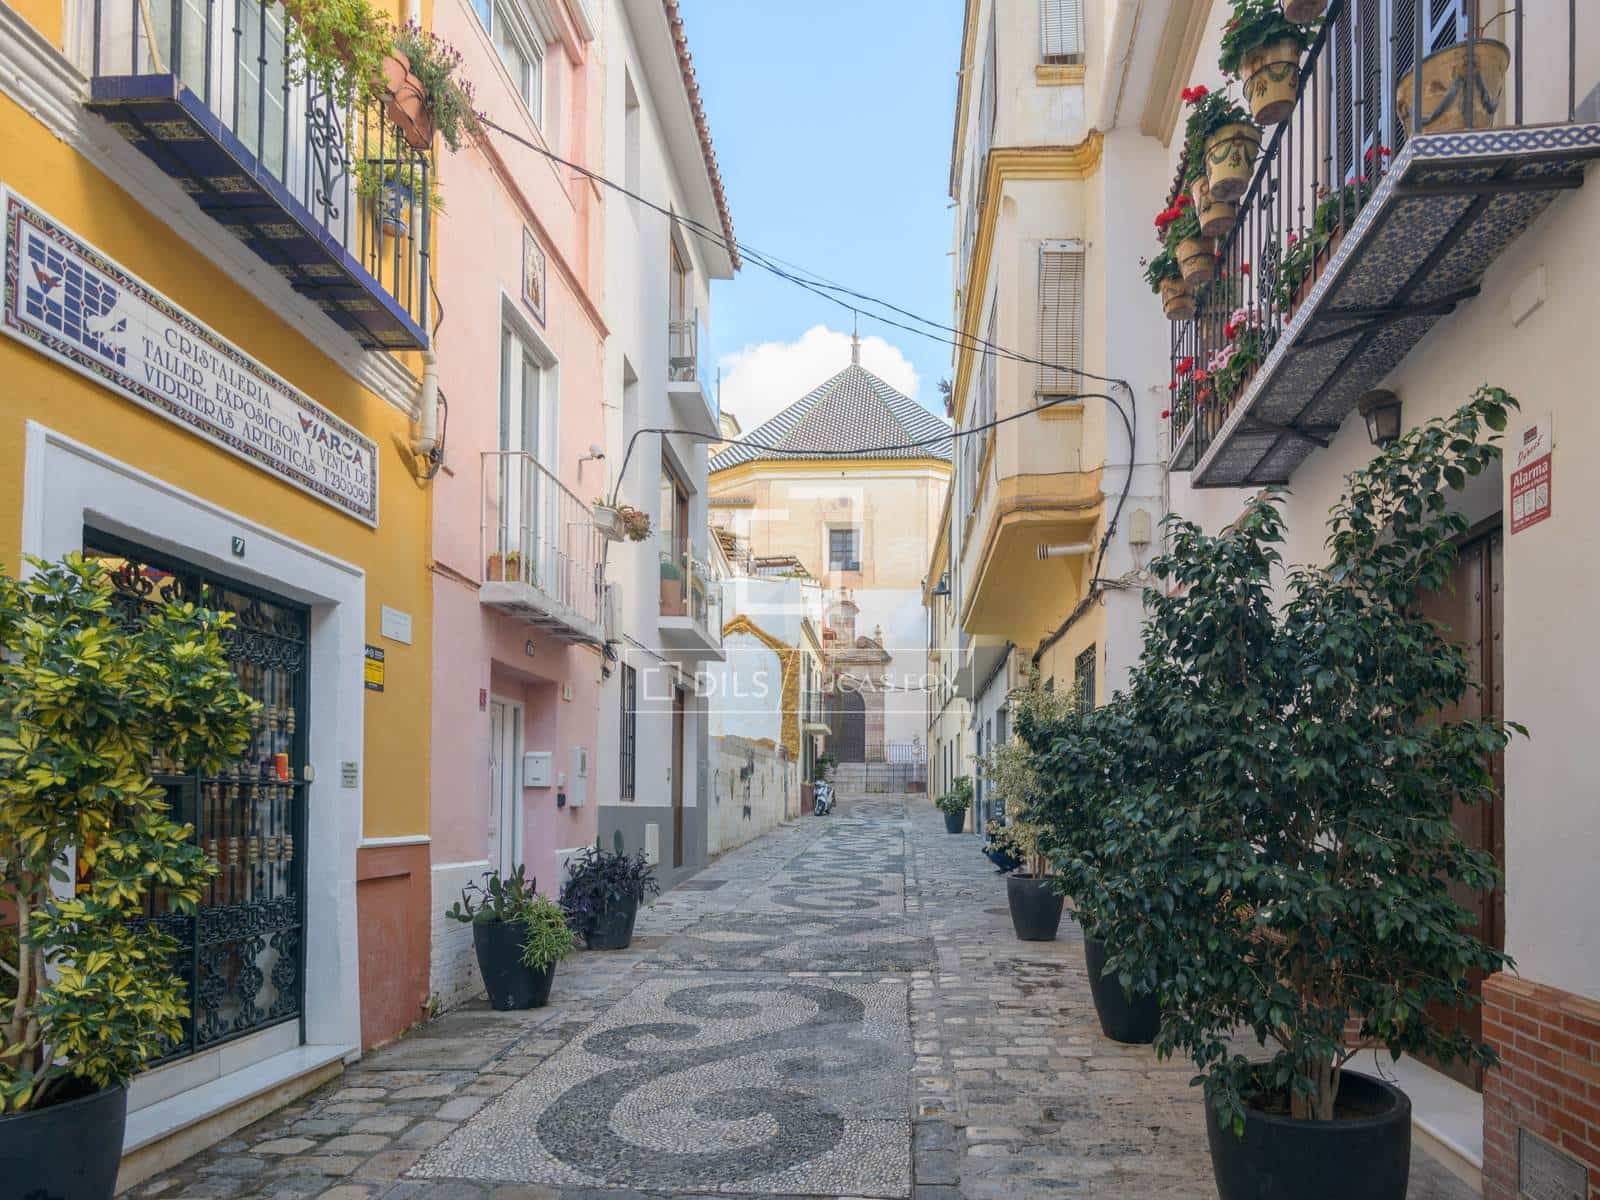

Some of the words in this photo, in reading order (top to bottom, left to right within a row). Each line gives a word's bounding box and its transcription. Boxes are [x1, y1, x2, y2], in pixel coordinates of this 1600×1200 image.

[164, 328, 272, 410] CRISTALERIA
[143, 360, 235, 429] VIDRIERAS
[242, 420, 316, 475] ARTISTICAS
[297, 411, 364, 469] VIARCA
[306, 438, 313, 455] Y
[319, 446, 351, 479] VENTA
[355, 468, 369, 488] DE
[1513, 461, 1548, 489] Alarma
[235, 538, 244, 553] 7
